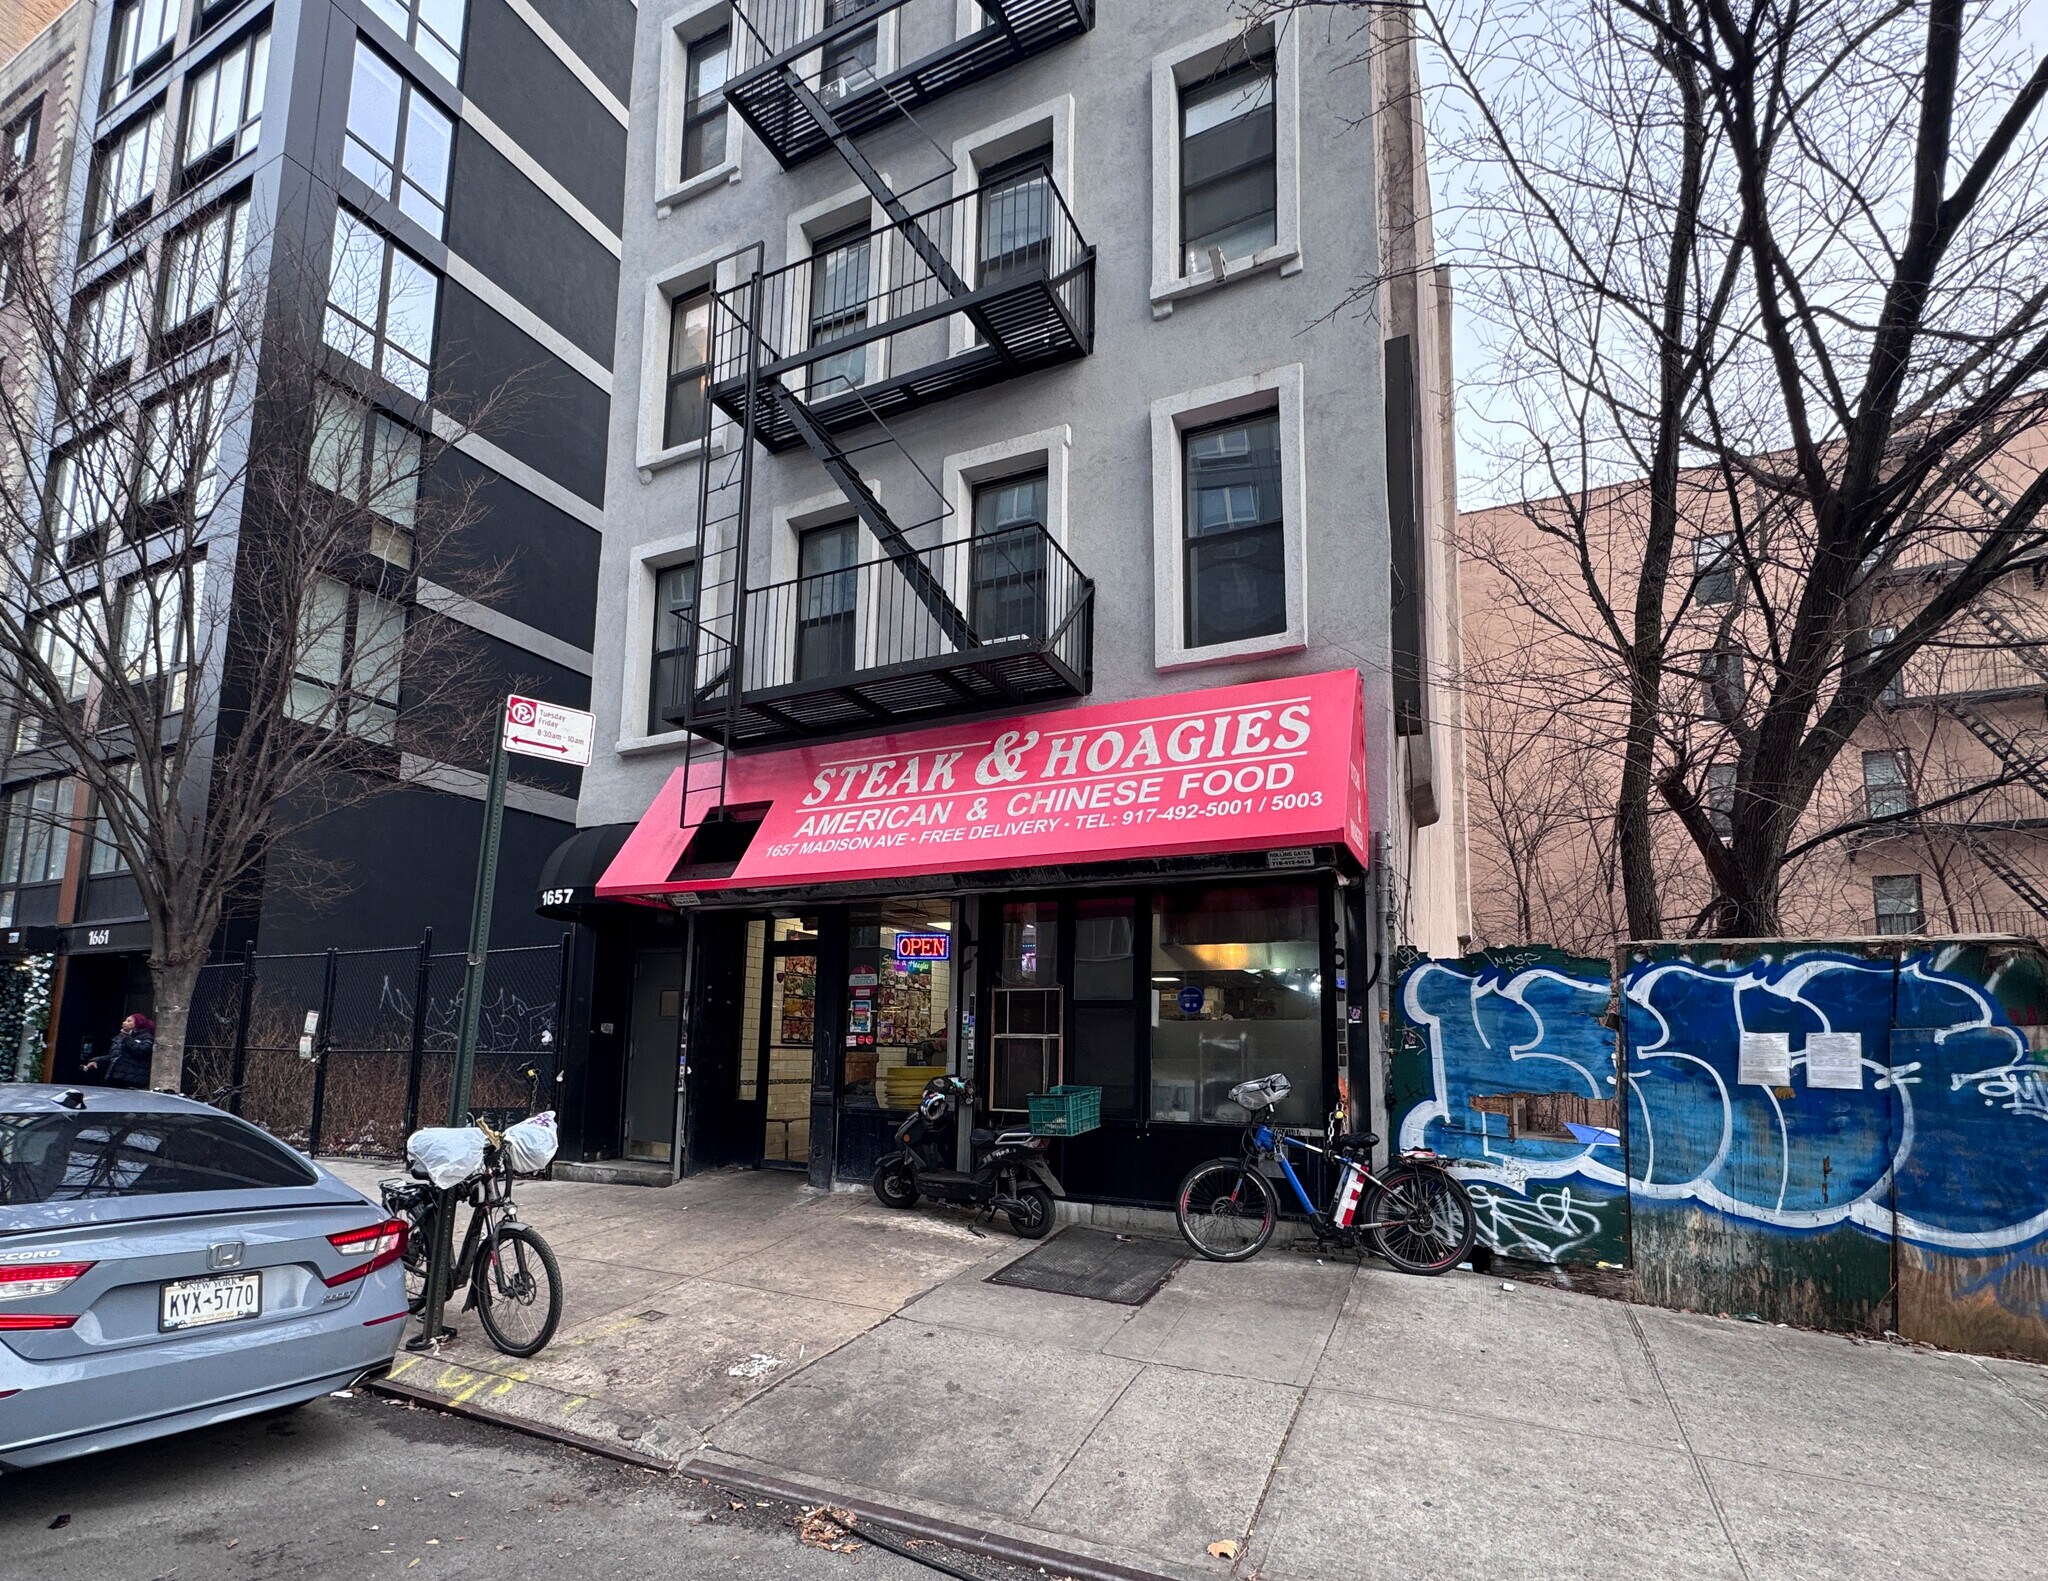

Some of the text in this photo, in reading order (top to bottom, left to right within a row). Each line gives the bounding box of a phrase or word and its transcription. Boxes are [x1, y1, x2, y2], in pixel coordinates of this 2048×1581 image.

[538, 717, 558, 729] Friday
[540, 709, 566, 722] Tuesday
[802, 751, 963, 806] STEAK
[975, 730, 1040, 786] &
[1040, 705, 1311, 779] HOAGIES
[793, 763, 1295, 838] AMERICAN & CHINESE FOOD
[766, 843, 799, 858] 1657
[799, 836, 873, 855] MADISON
[874, 833, 908, 848] AVE
[918, 827, 970, 844] FREE
[968, 817, 1061, 840] DELIVERY
[1076, 813, 1117, 830] TEL:
[1121, 798, 1253, 826] 917-492-5001
[1271, 791, 1323, 811] 5003
[542, 888, 574, 906] 1657
[88, 929, 110, 945] 1661
[900, 938, 946, 956] OPEN
[189, 1282, 210, 1291] NEW
[214, 1278, 238, 1288] YORK
[170, 1284, 253, 1317] KYX 5770
